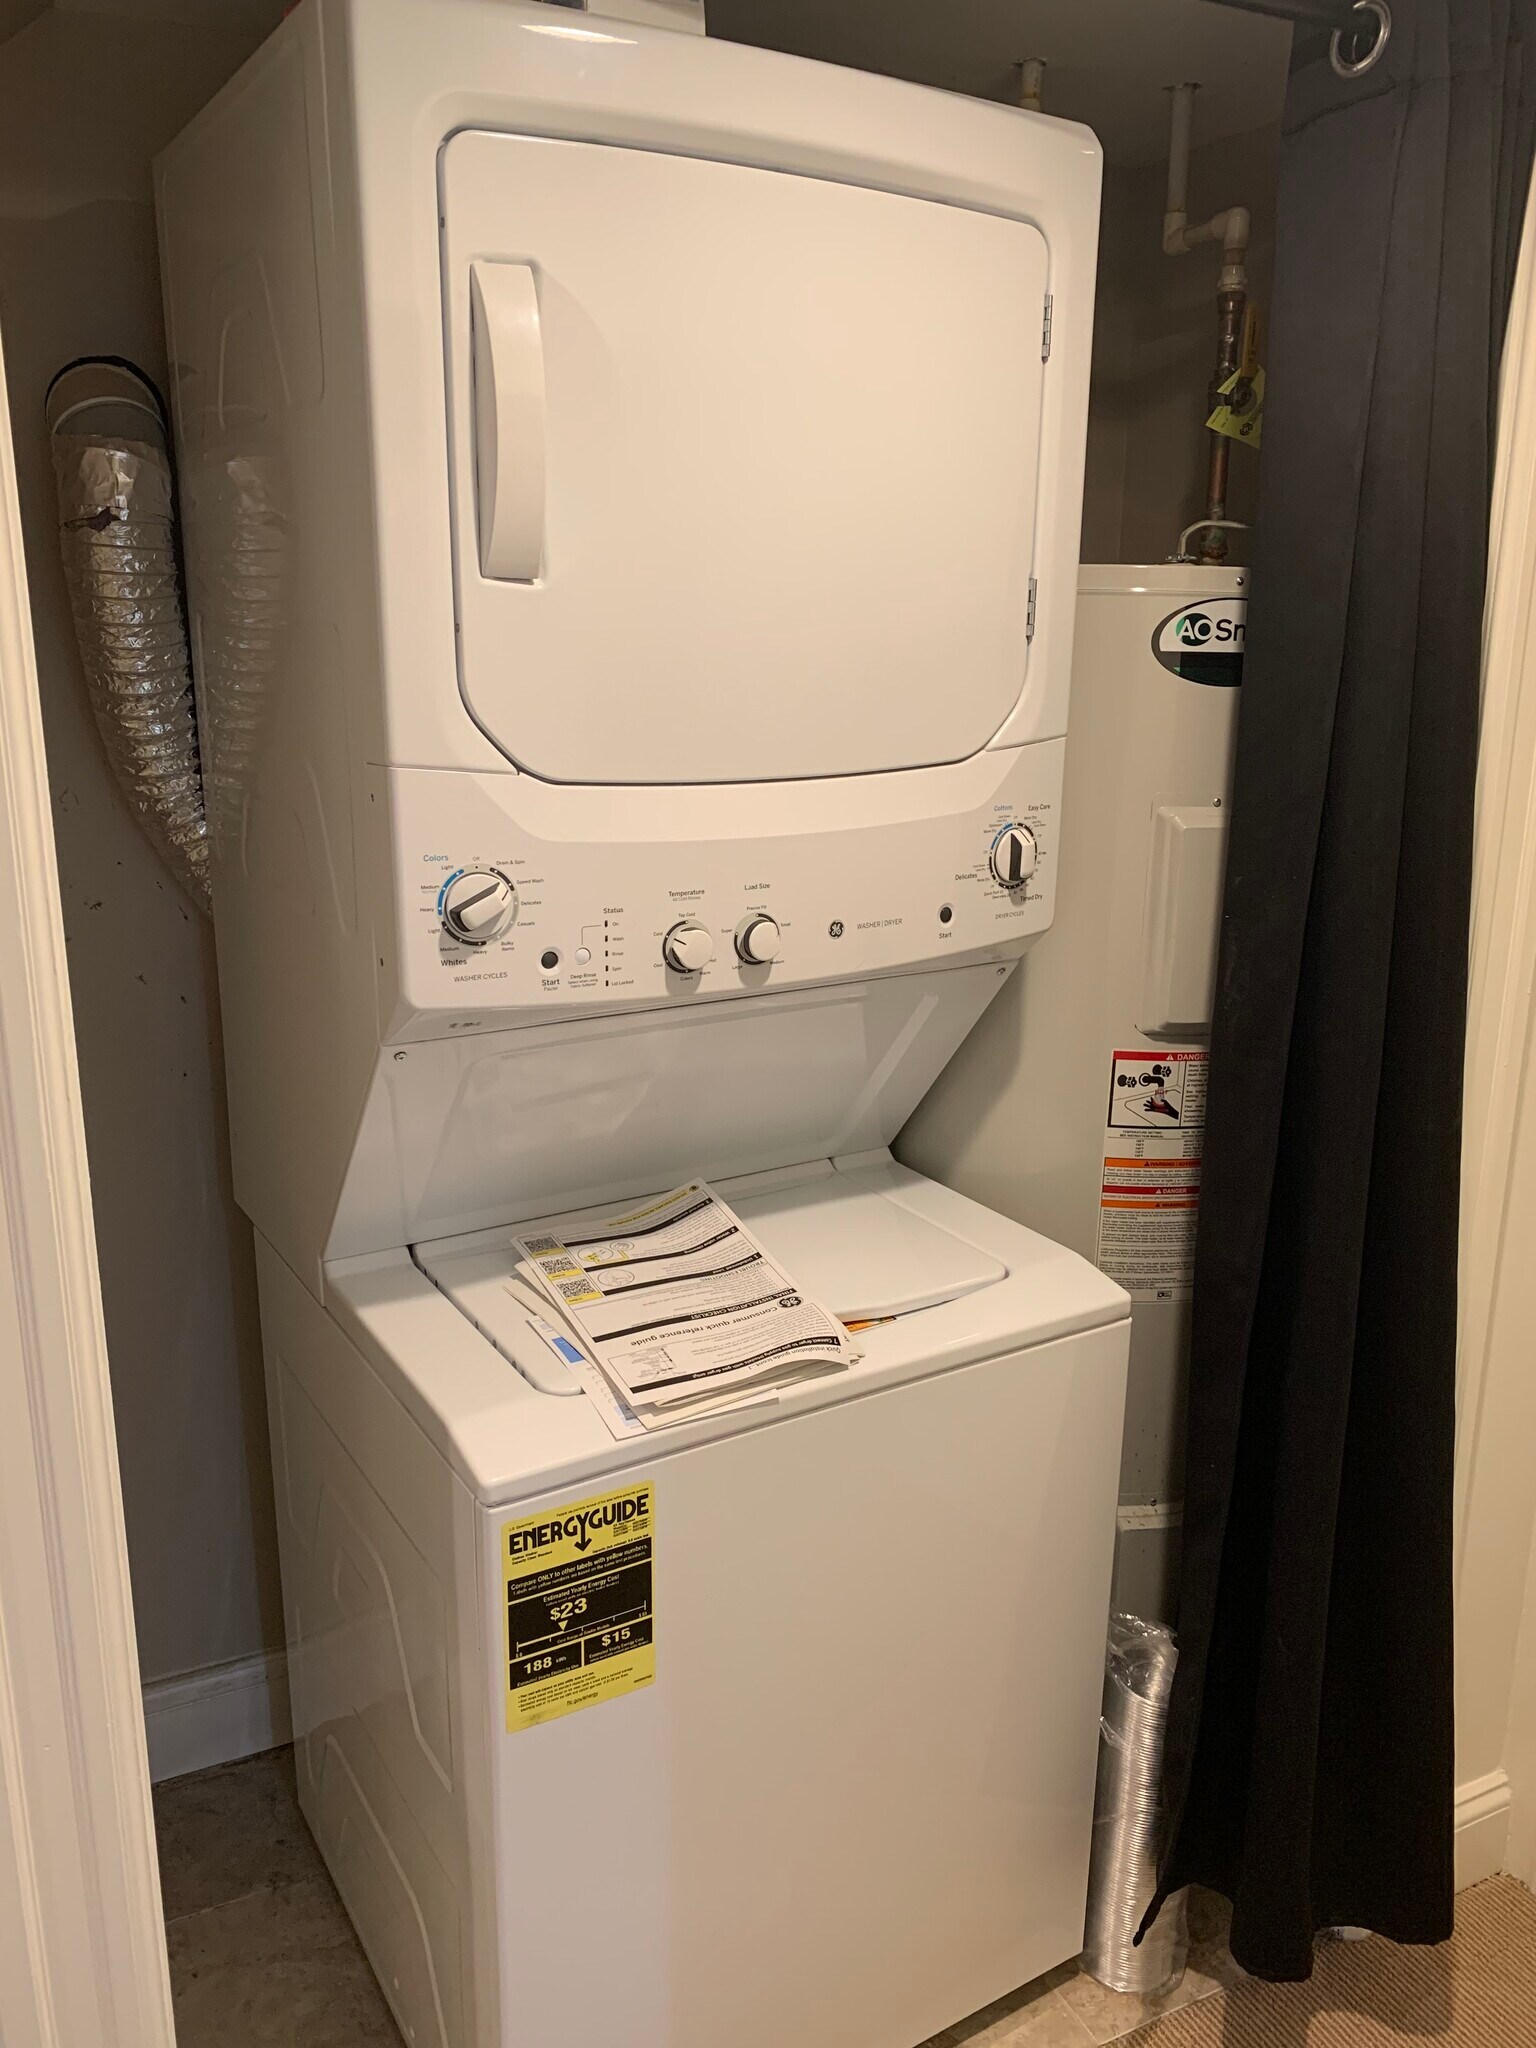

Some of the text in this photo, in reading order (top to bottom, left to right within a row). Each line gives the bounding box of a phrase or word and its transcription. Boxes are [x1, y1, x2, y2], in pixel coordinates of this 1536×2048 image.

[423, 854, 449, 862] Colors
[955, 873, 977, 881] Delicates
[668, 889, 705, 898] Temperature
[995, 910, 1024, 920] DRYER CYCLES
[857, 921, 881, 930] WASHER
[441, 958, 467, 967] Whites
[454, 972, 508, 982] WASHER CYCLES
[541, 979, 560, 987] Start
[699, 1260, 763, 1282] TROUBLESHOOTING
[691, 1290, 793, 1320] FINAL INSTALLATION CHECKLIST
[630, 1307, 778, 1346] Consumer quick reference guide
[798, 1338, 812, 1346] dryer
[764, 1347, 781, 1357] supply
[773, 1351, 791, 1360] guide
[509, 1493, 649, 1556] ENERGYGUIDE
[510, 1576, 536, 1591] Compare
[537, 1572, 553, 1582] ONLY
[561, 1565, 575, 1575] other
[576, 1559, 592, 1570] labels
[593, 1556, 605, 1564] with
[606, 1550, 623, 1562] yellow
[623, 1542, 648, 1555] numbers.
[537, 1580, 551, 1589] yellow
[551, 1574, 569, 1583] numbers
[543, 1589, 569, 1603] Estimated
[570, 1583, 587, 1595] Yearly
[587, 1577, 606, 1590] Energy
[607, 1573, 619, 1582] Cost
[550, 1596, 587, 1622] $23
[601, 1626, 630, 1648] $15
[588, 1648, 608, 1658] Estimated
[608, 1644, 620, 1652] Yearly
[621, 1639, 634, 1648] Energy
[523, 1655, 552, 1675] 188
[516, 1676, 537, 1687] Estimated
[538, 1672, 550, 1680] Yearly
[550, 1665, 570, 1676] Electricity
